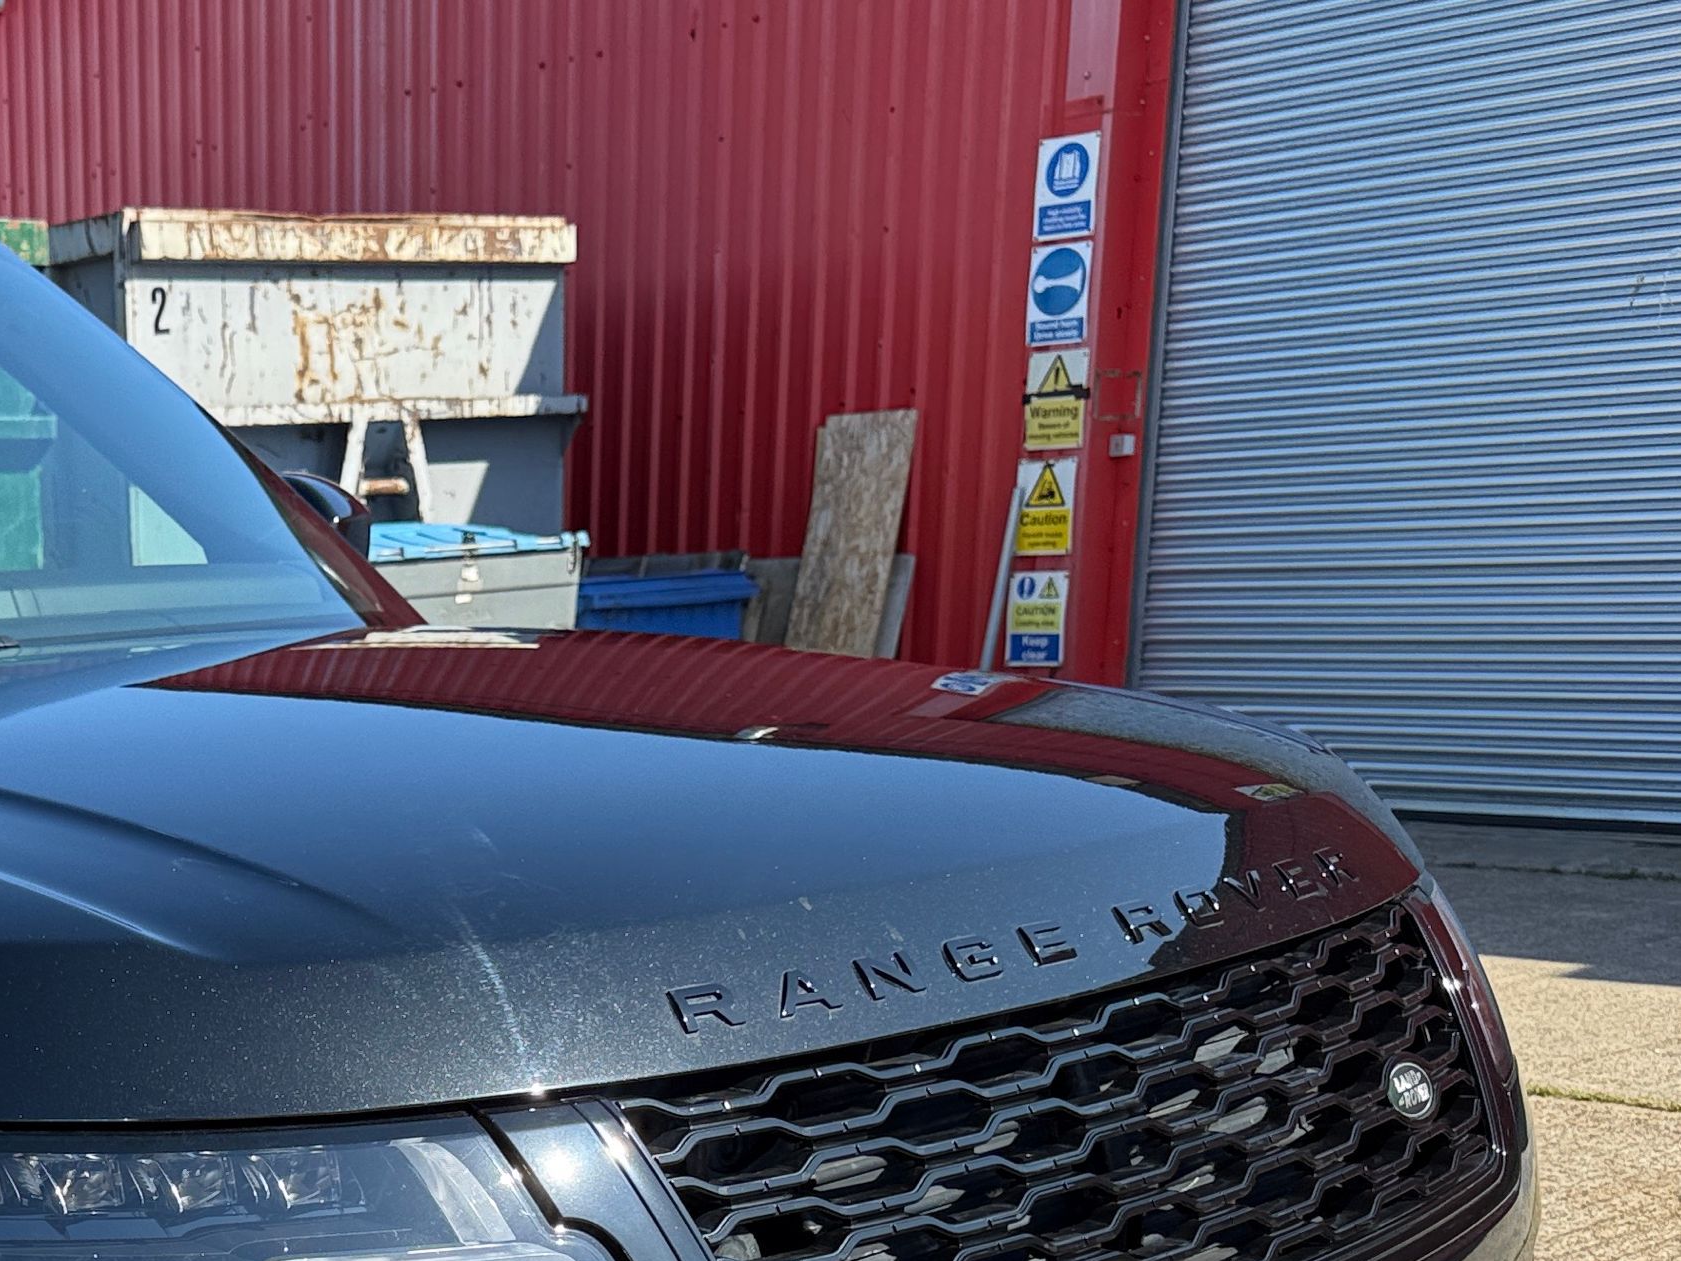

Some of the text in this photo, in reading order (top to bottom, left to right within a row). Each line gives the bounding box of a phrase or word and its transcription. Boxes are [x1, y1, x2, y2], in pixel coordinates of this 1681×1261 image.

[152, 287, 170, 336] 2
[1029, 406, 1078, 420] Warning
[1020, 511, 1067, 527] Caution
[1016, 605, 1056, 616] CAUTION
[666, 847, 1361, 1035] RANGE ROVER
